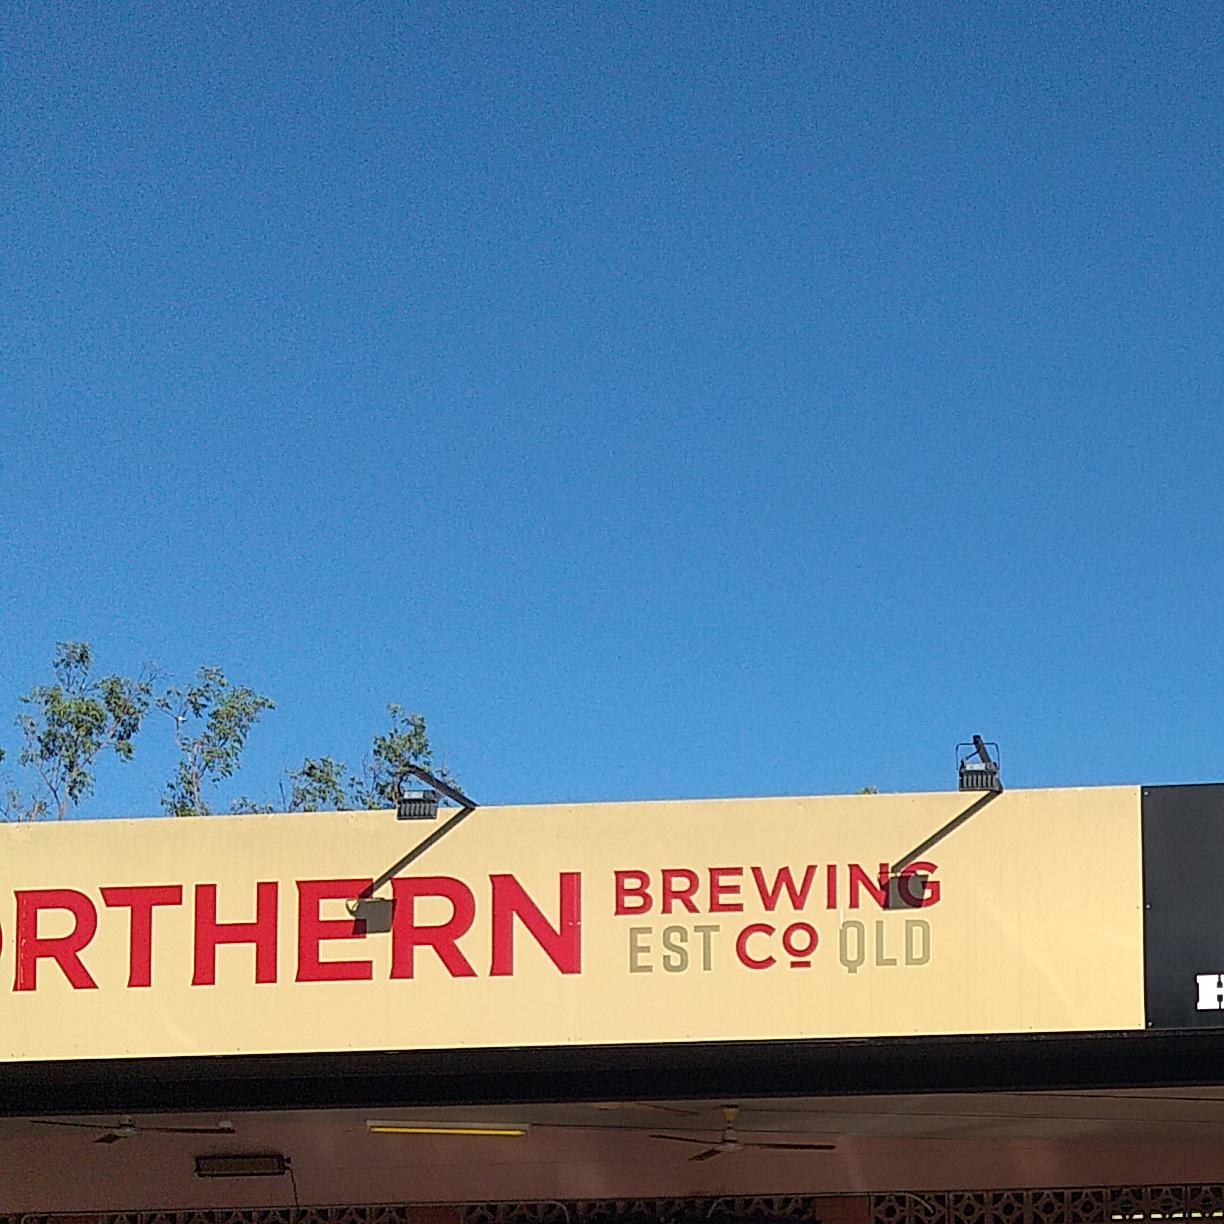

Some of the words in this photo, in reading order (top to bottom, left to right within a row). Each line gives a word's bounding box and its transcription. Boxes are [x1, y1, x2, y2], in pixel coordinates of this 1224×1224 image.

[614, 861, 941, 916] BREWING
[0, 872, 582, 991] RTHERN
[629, 924, 720, 973] EST
[840, 919, 931, 973] QLD
